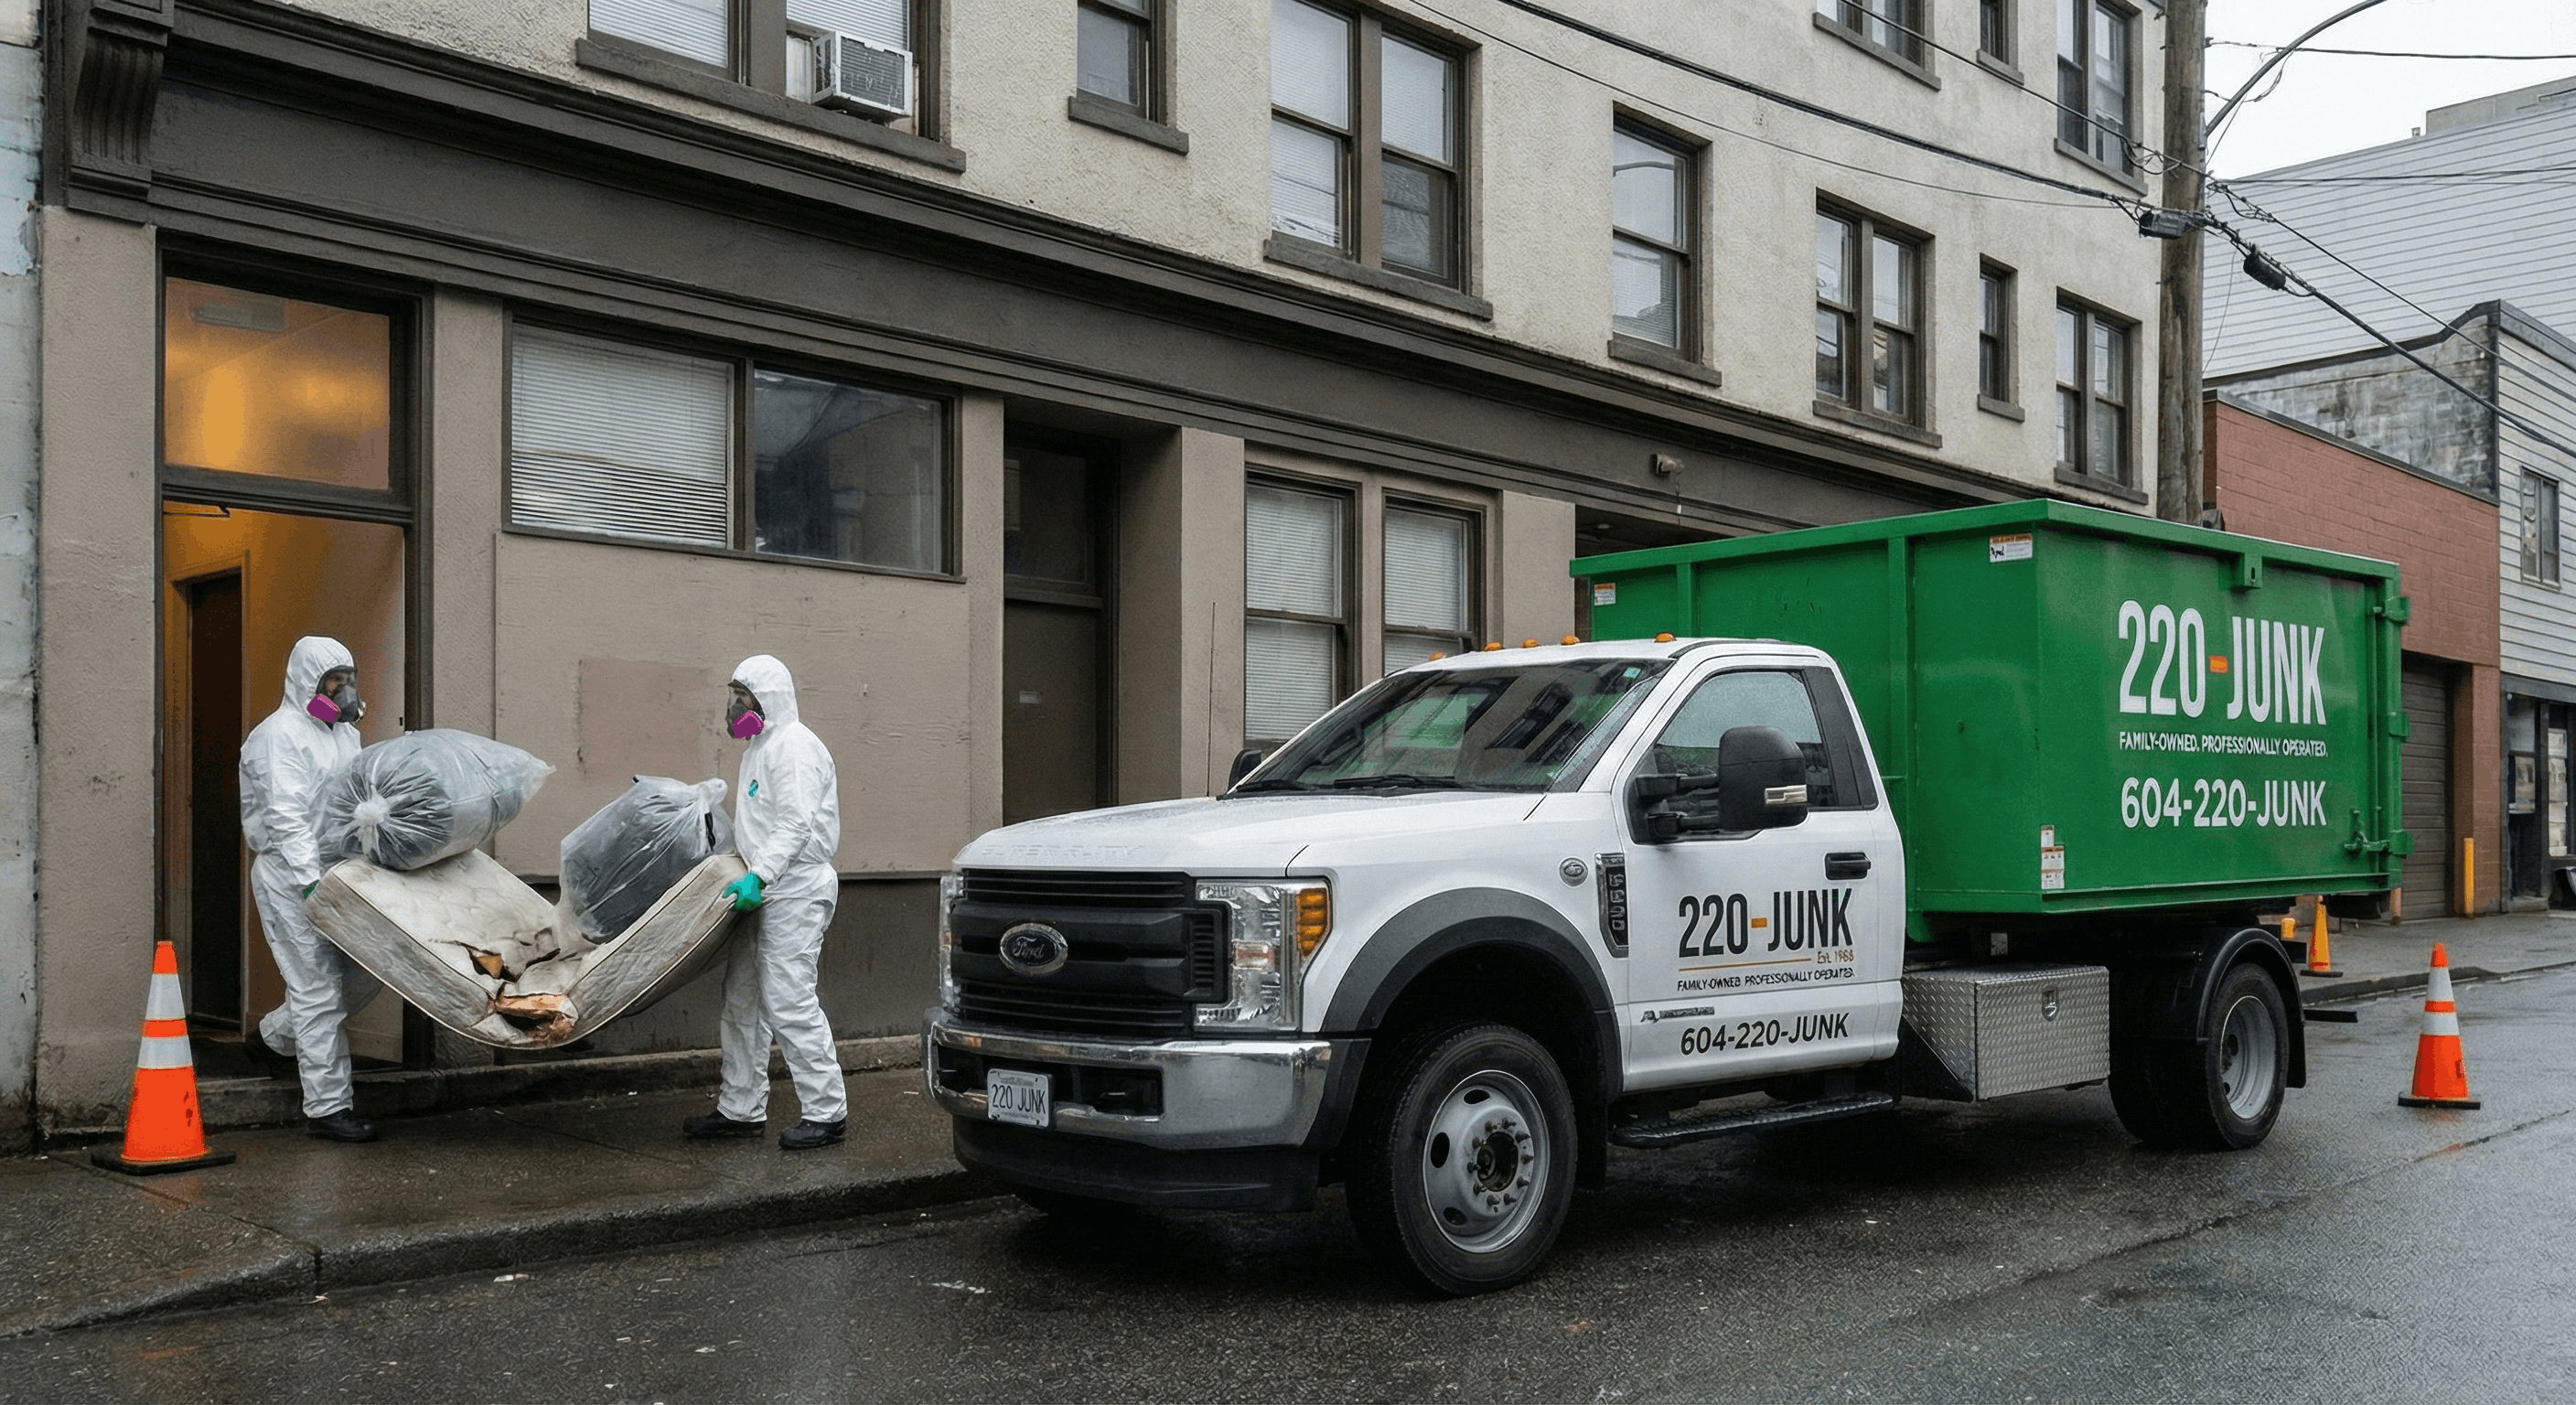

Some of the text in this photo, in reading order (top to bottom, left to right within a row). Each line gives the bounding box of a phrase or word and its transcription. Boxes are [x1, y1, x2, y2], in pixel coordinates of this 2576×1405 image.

[2119, 600, 2326, 725] 220-JUNK
[2120, 731, 2200, 752] FAMILY-OWNED.
[2201, 735, 2281, 756] PROFESSIONALLY
[2121, 777, 2327, 828] 604-220-JUNK
[1679, 887, 1853, 959] 220-JUNK
[1680, 1013, 1850, 1056] 604-220-JUNK
[992, 1083, 1046, 1115] 220 JUNK
